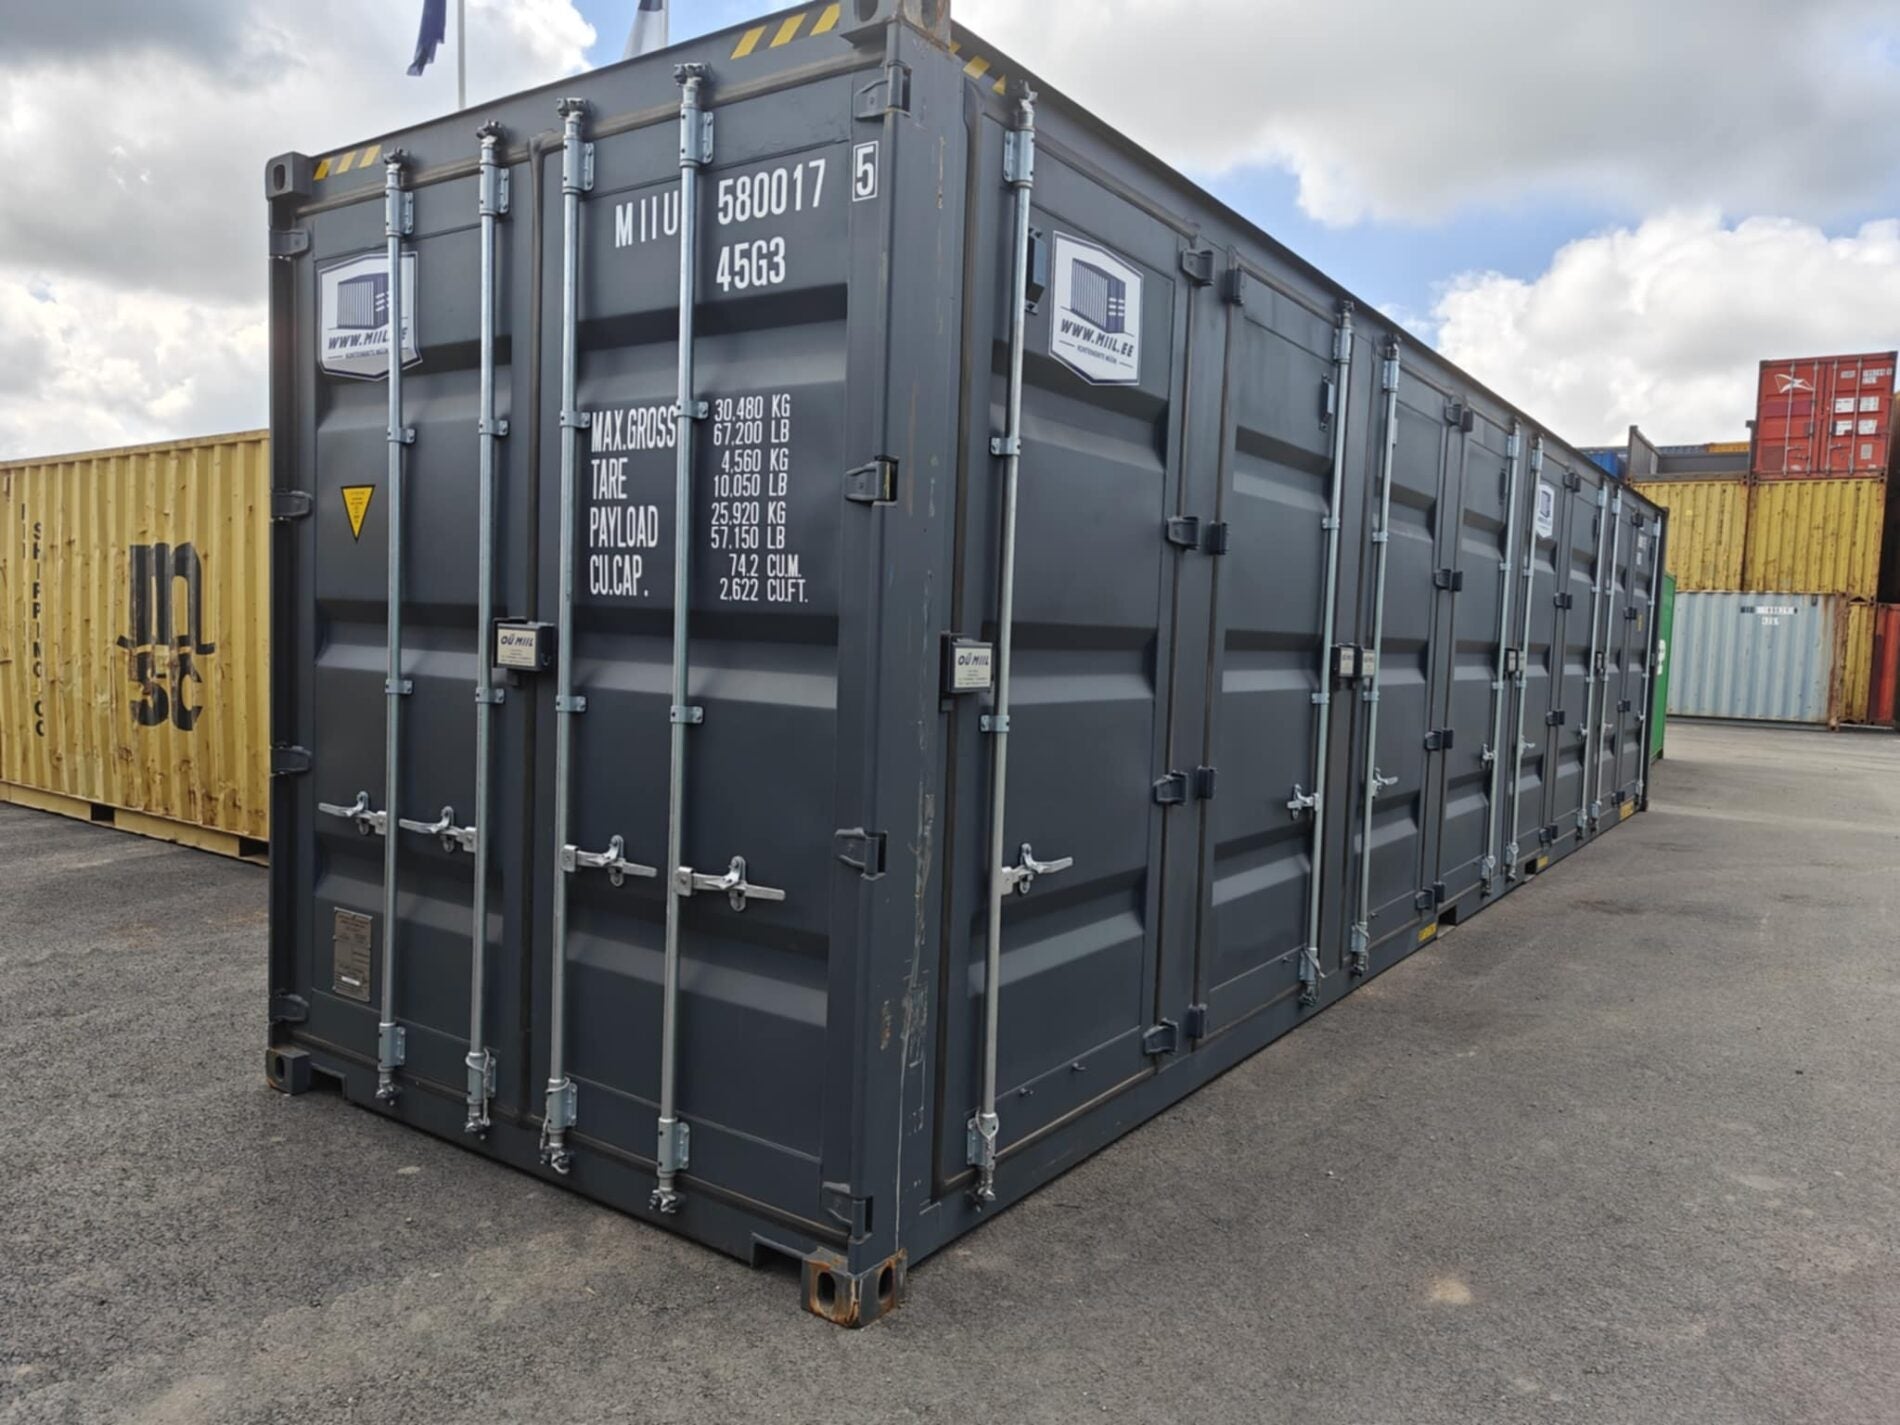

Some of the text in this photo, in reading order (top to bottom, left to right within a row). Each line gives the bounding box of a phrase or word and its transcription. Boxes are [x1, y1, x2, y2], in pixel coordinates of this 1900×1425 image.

[614, 145, 875, 248] MIIU 580017 5
[715, 236, 786, 292] 45G3
[1060, 318, 1134, 358] WWW.MIIL.EE
[715, 393, 790, 422] 30,480 KG
[591, 405, 676, 453] MAX.GROSS
[713, 419, 790, 446] 67,200 LB
[721, 447, 789, 474] 4,560 KG
[591, 457, 628, 500] TARE
[713, 472, 788, 498] 10,050 LB
[589, 505, 659, 548] PAYLOAD
[711, 501, 786, 526] 25,920 KG
[710, 526, 785, 550] 57,150 LB
[728, 553, 802, 578] 74.2 CU.M.
[719, 577, 809, 603] 2,622 CU.FT.
